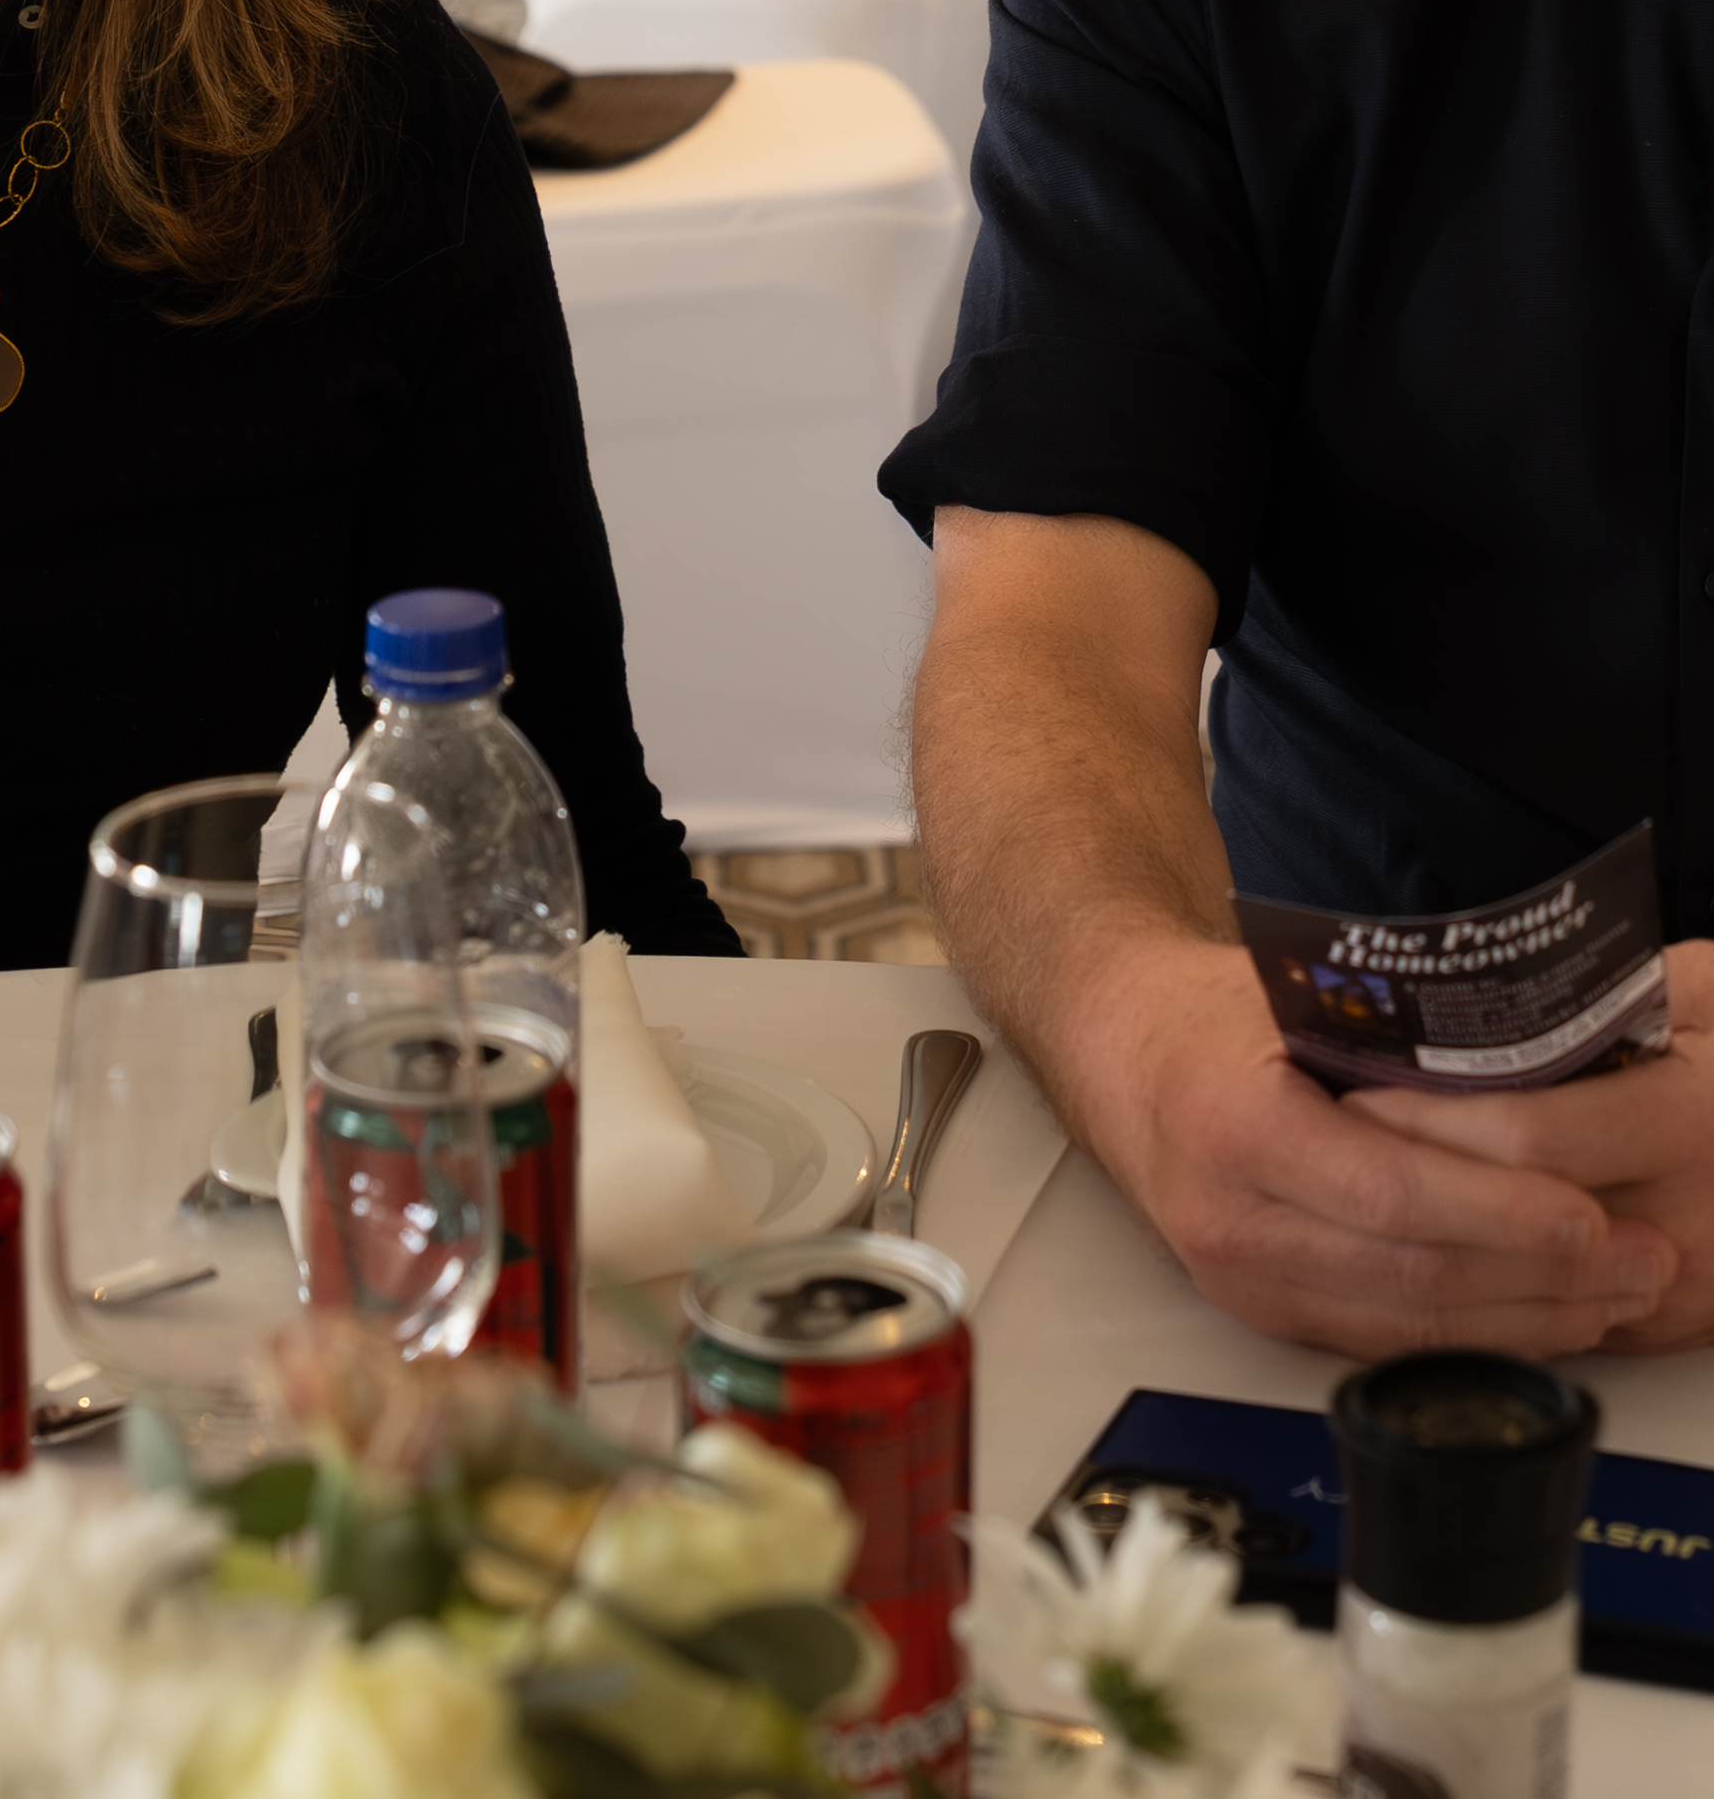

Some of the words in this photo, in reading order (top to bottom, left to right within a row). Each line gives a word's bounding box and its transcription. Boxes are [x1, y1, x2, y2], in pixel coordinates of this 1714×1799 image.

[1327, 899, 1596, 975] Homeowner
[1339, 921, 1428, 953] The
[1441, 879, 1577, 952] Proud
[1574, 1516, 1713, 1560] JUST
